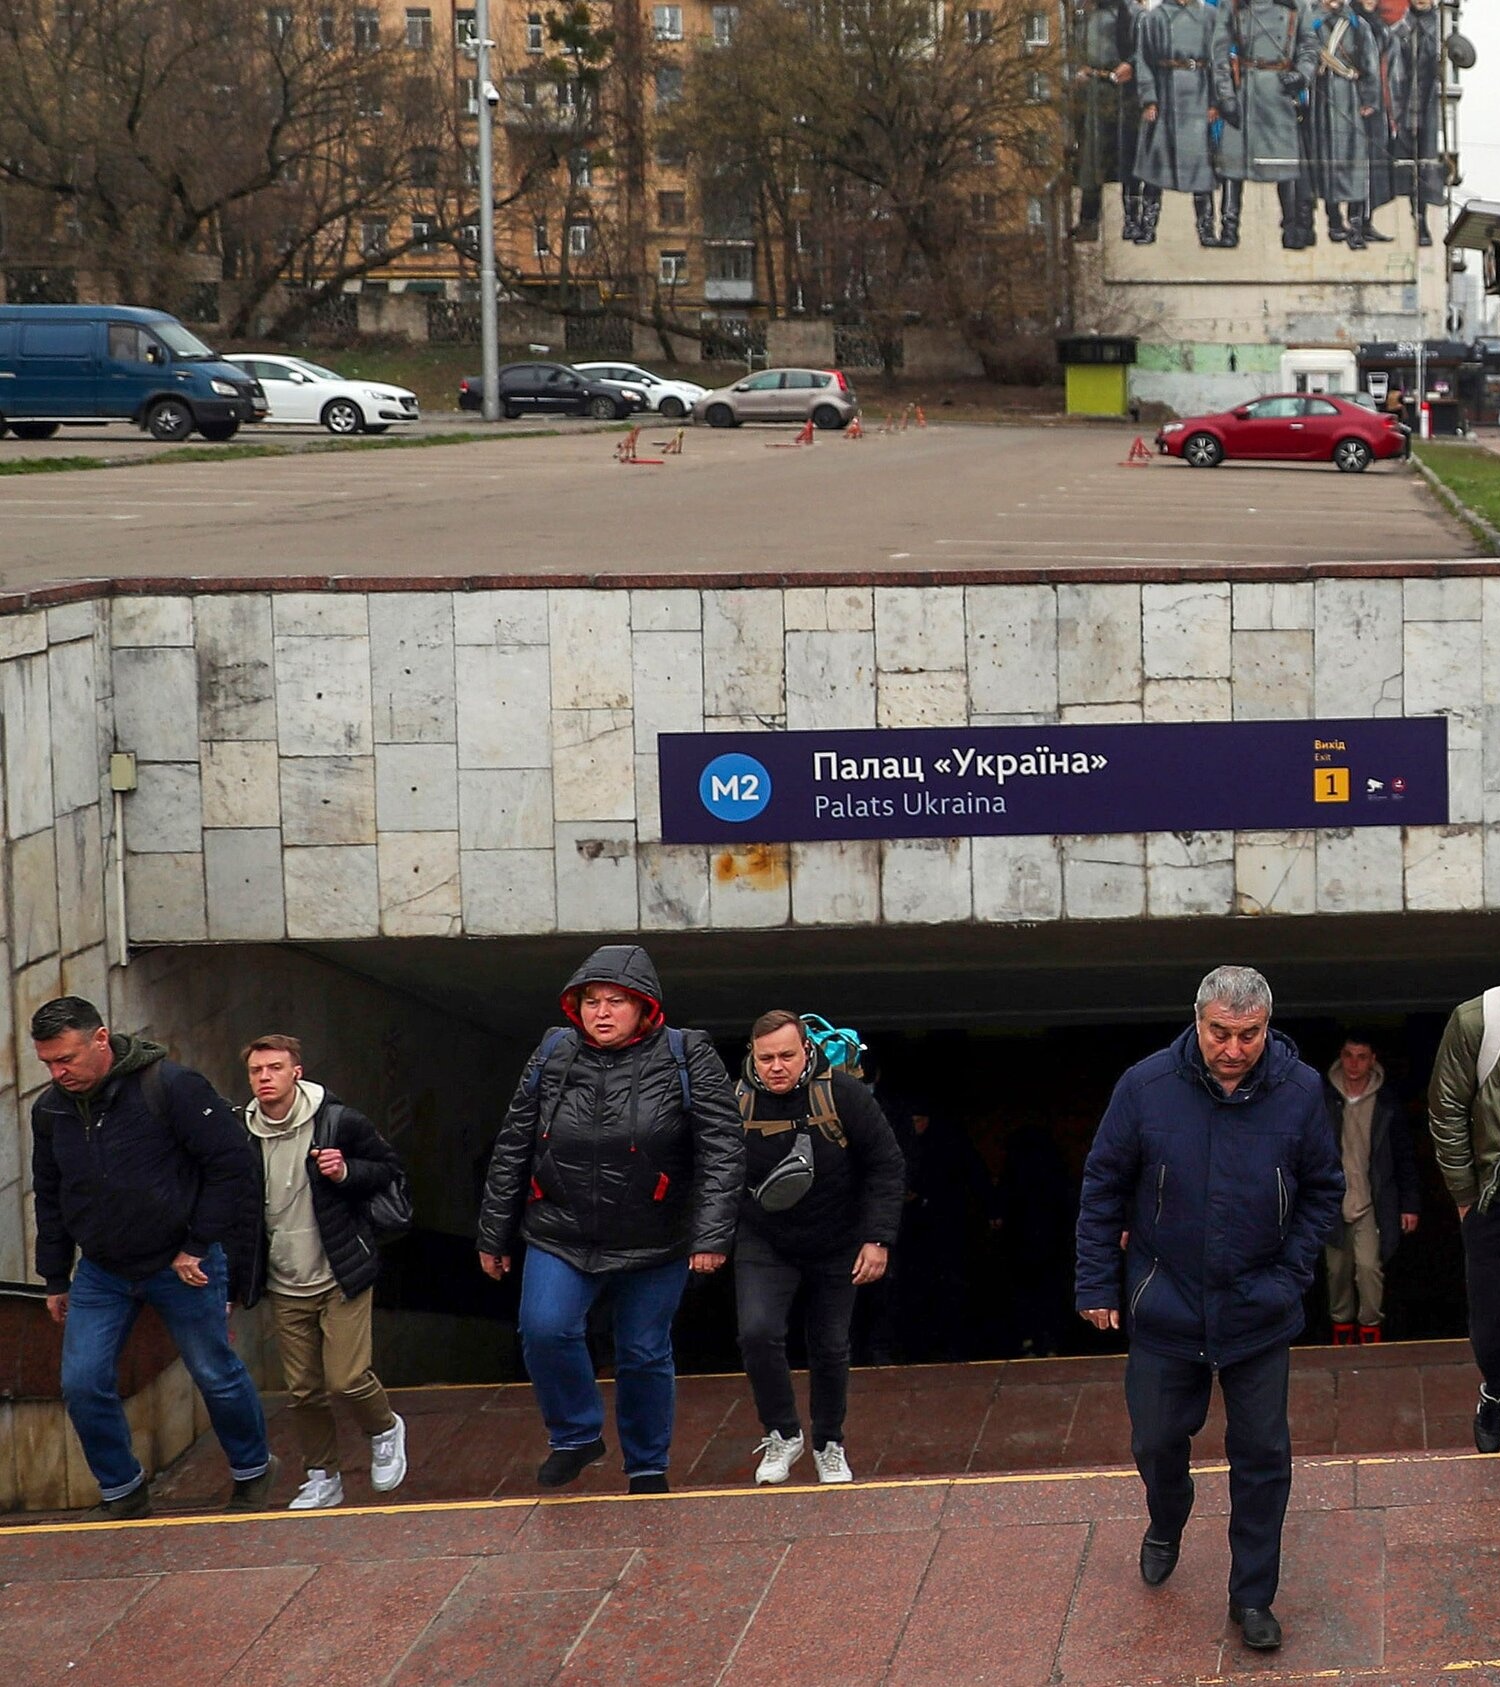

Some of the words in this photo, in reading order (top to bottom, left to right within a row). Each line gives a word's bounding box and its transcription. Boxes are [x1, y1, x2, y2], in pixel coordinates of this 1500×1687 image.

[1314, 740, 1346, 751] Вихід
[1314, 752, 1331, 761] Exit
[813, 751, 925, 783] Палац
[933, 746, 1109, 785] «Україна»
[1325, 773, 1338, 795] 1
[815, 793, 895, 818] Palats
[903, 791, 1007, 816] Ukraina
